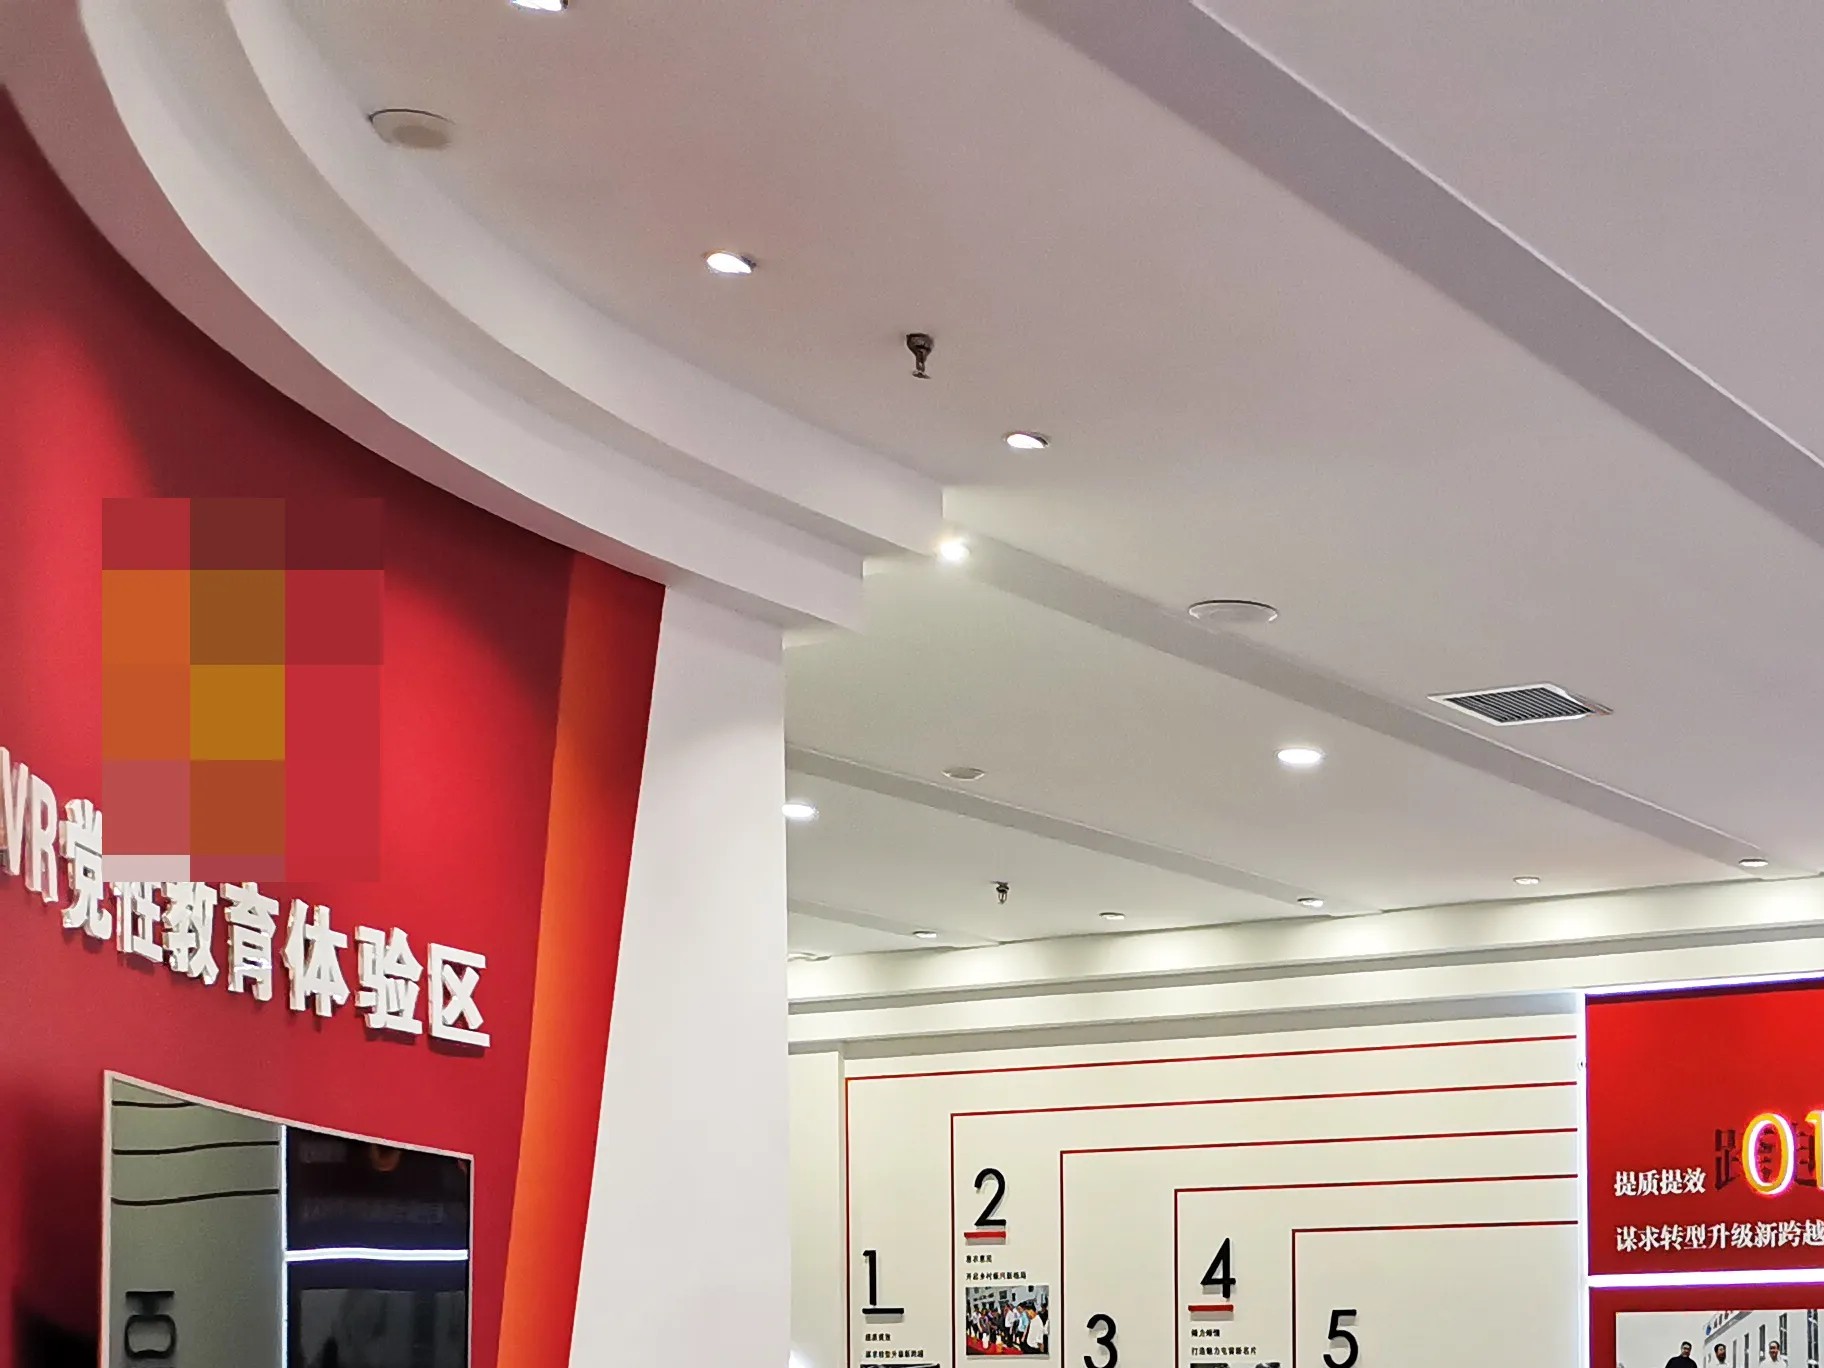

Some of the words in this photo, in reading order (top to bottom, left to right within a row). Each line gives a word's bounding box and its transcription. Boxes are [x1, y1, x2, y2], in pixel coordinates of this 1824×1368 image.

[974, 1168, 1007, 1226] 2
[1614, 1168, 1707, 1197] 提质提效
[863, 1250, 877, 1306] 1
[1200, 1237, 1236, 1299] 4
